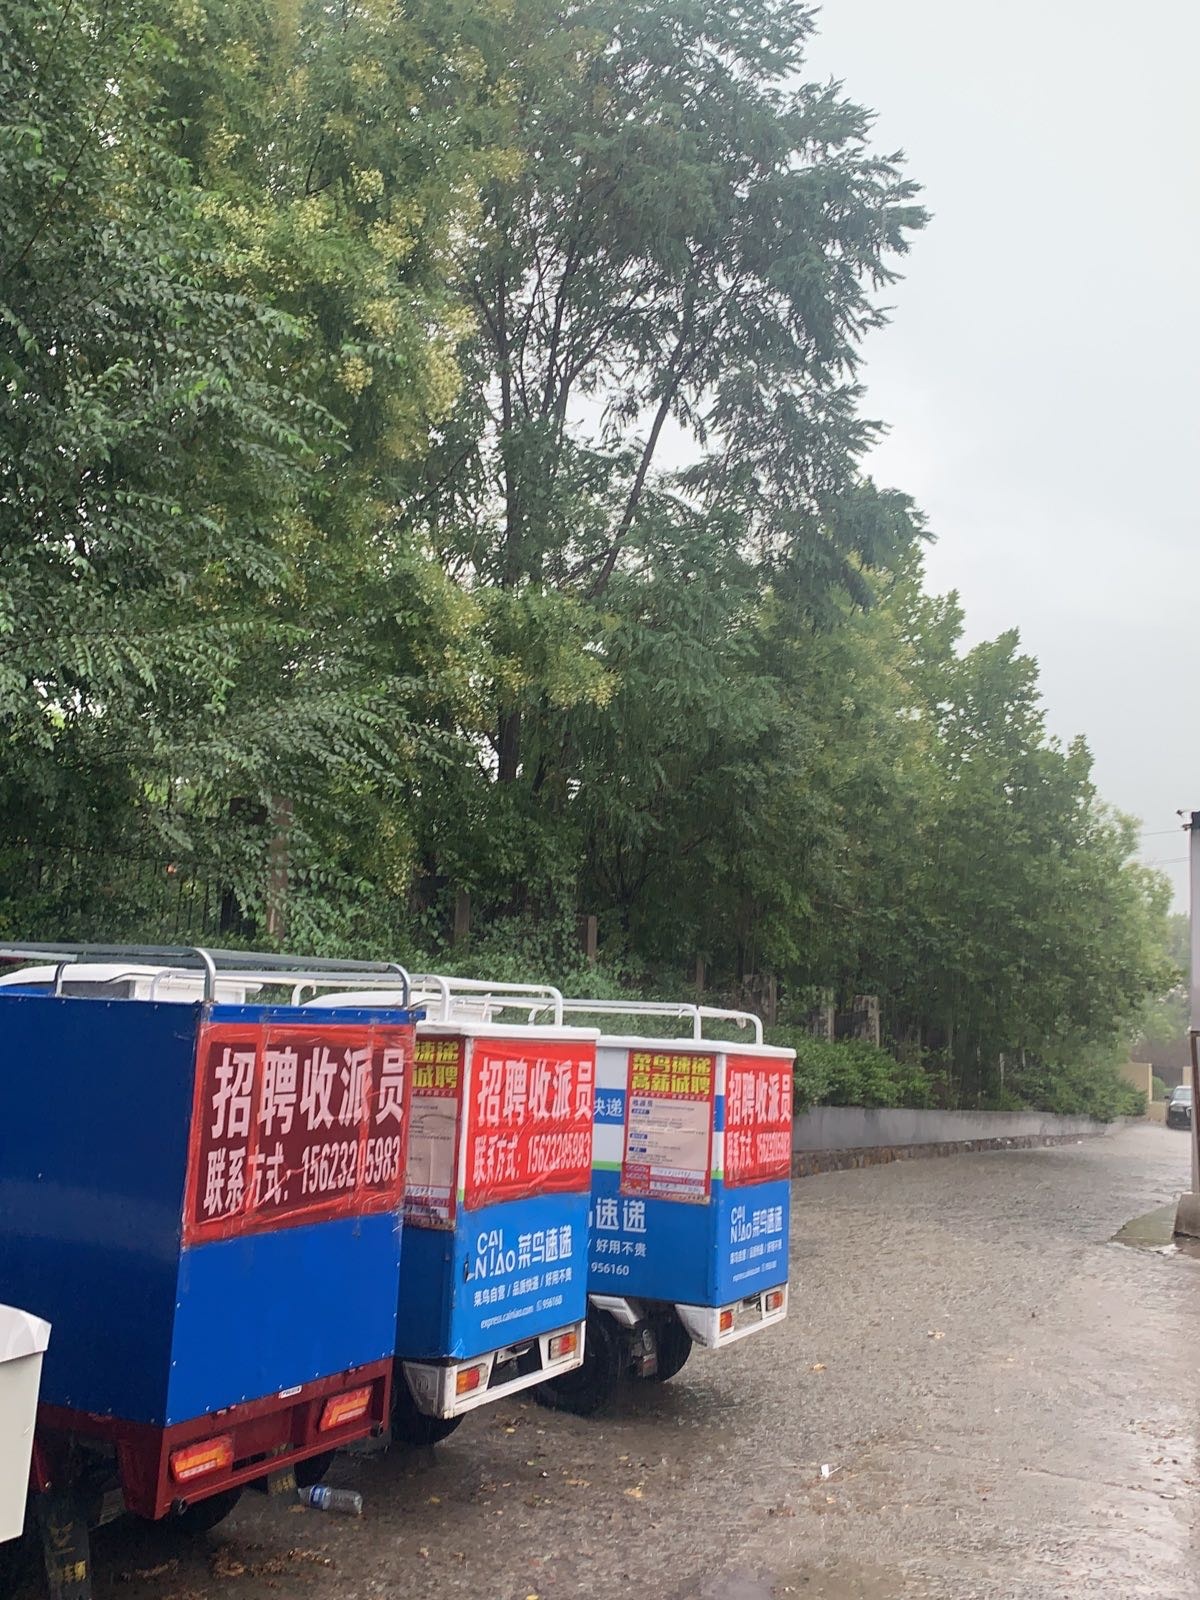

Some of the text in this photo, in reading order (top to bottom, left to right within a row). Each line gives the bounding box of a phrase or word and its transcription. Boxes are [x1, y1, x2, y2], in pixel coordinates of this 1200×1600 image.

[211, 1046, 405, 1139] 招聘收派员
[477, 1056, 593, 1128] 招聘收派员
[631, 1072, 711, 1095] 高薪诚聘
[727, 1070, 791, 1126] 招聘收派员
[588, 1197, 647, 1233] 速递
[477, 1228, 503, 1255] CAI
[518, 1224, 572, 1270] 菜鸟速递
[595, 1238, 647, 1257] 好用不贵
[591, 1261, 630, 1276] 956160
